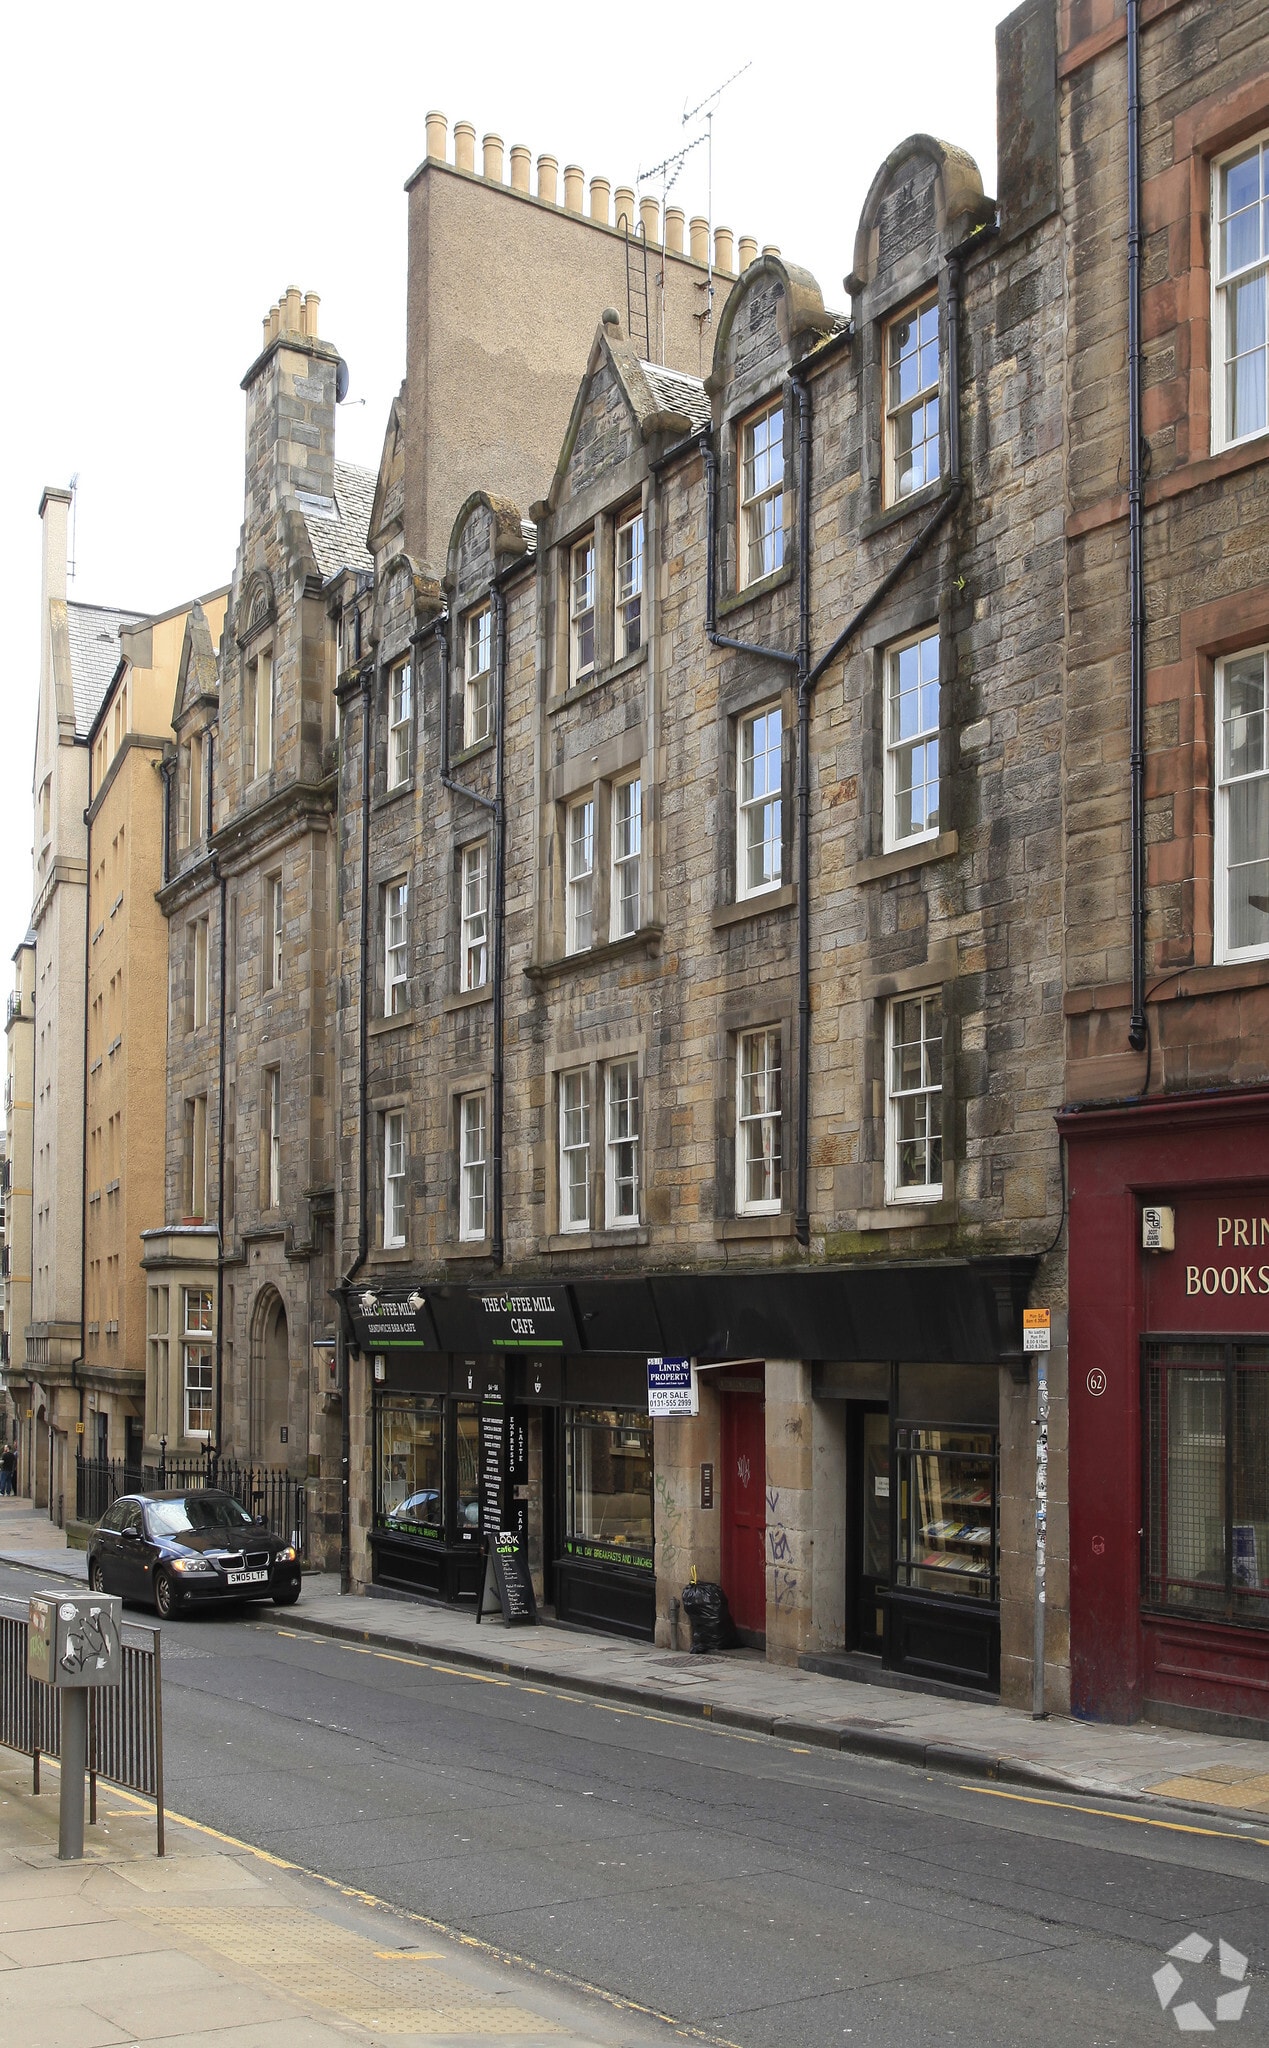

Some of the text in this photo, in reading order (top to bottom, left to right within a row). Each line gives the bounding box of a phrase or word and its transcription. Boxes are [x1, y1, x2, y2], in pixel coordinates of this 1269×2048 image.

[1186, 1265, 1269, 1295] BOOKS
[359, 1302, 375, 1316] THE
[481, 1297, 501, 1312] THE
[531, 1296, 556, 1312] MILL
[368, 1323, 393, 1333] SANDWICH
[404, 1322, 417, 1332] CAFE
[510, 1318, 535, 1334] CAFE
[659, 1364, 681, 1372] LINTS
[650, 1373, 690, 1381] PROPERTY
[1091, 1374, 1102, 1389] 62
[652, 1391, 689, 1399] FOR SALE
[494, 1535, 520, 1545] LOOK
[584, 1547, 593, 1556] DAY
[593, 1548, 622, 1562] BREAKFASTS
[622, 1553, 632, 1564] AND
[633, 1555, 653, 1568] LUNCHES
